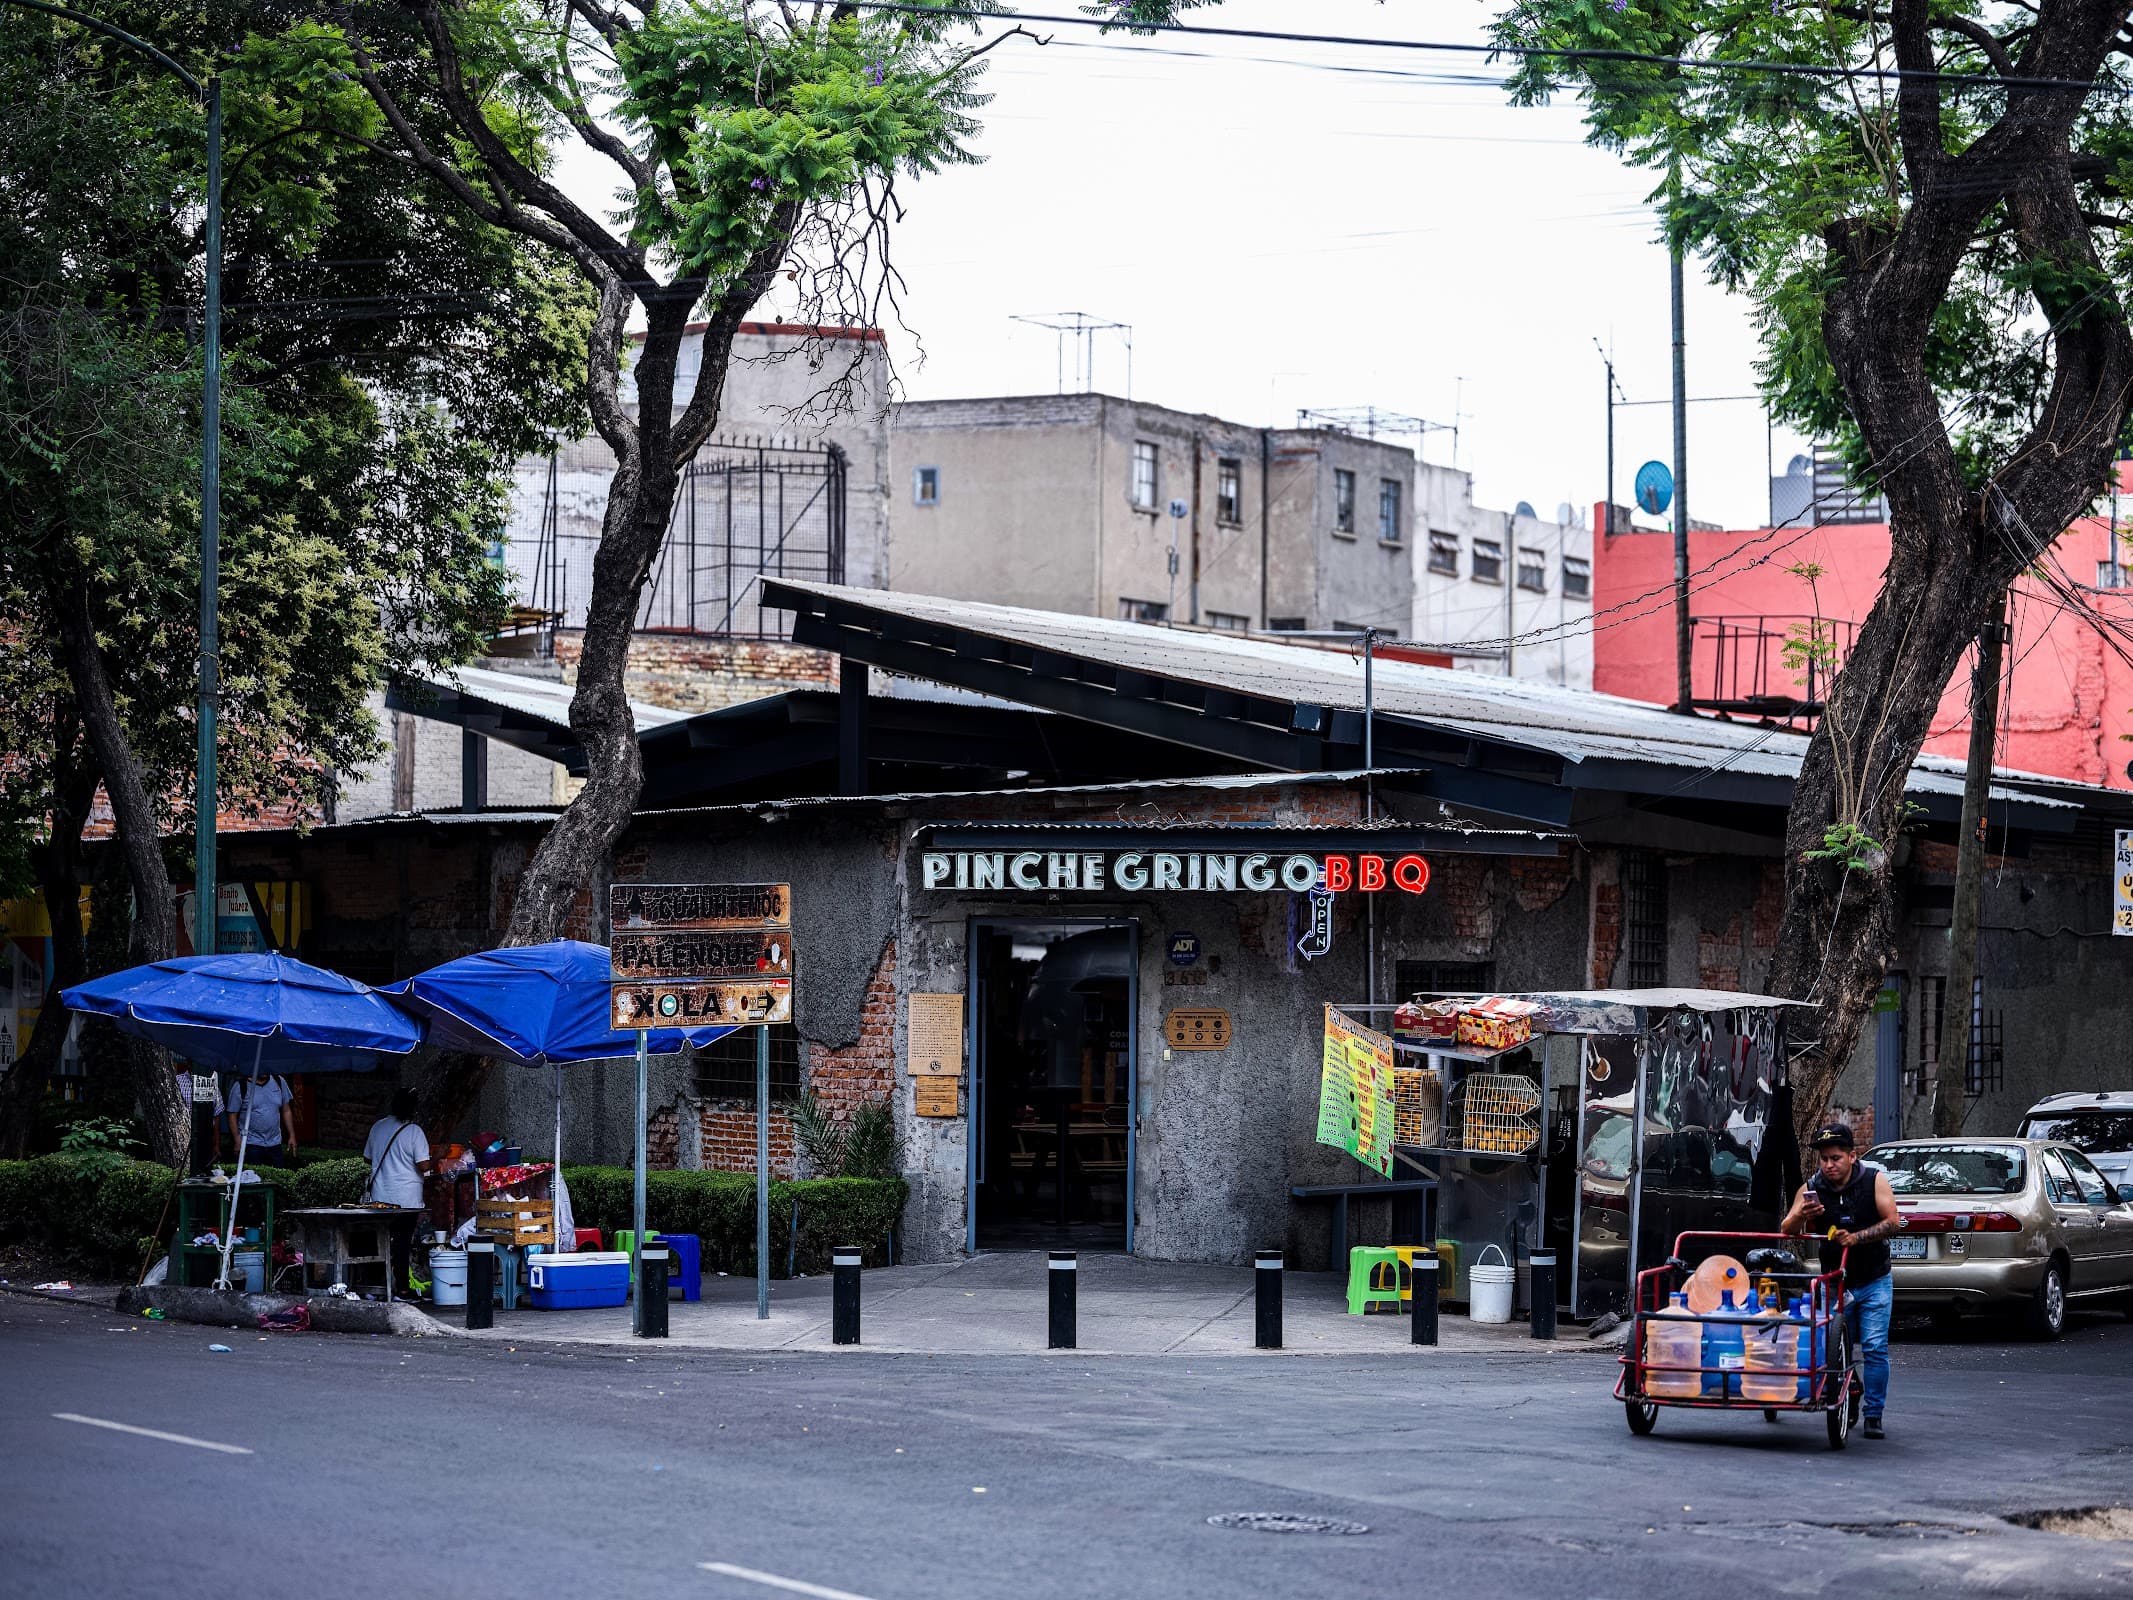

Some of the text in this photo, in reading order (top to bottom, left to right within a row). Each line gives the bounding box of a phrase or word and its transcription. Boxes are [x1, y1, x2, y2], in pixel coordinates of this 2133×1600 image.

[922, 852, 1430, 894] PINCHE GRINGO BBQ
[2119, 904, 2133, 912] VIS
[1316, 897, 1327, 948] OPEN
[2124, 912, 2133, 926] 2
[621, 942, 757, 969] PALENQUE
[1173, 940, 1195, 952] ADT
[633, 991, 722, 1018] XOLA
[1890, 1240, 1926, 1251] 38-MPR
